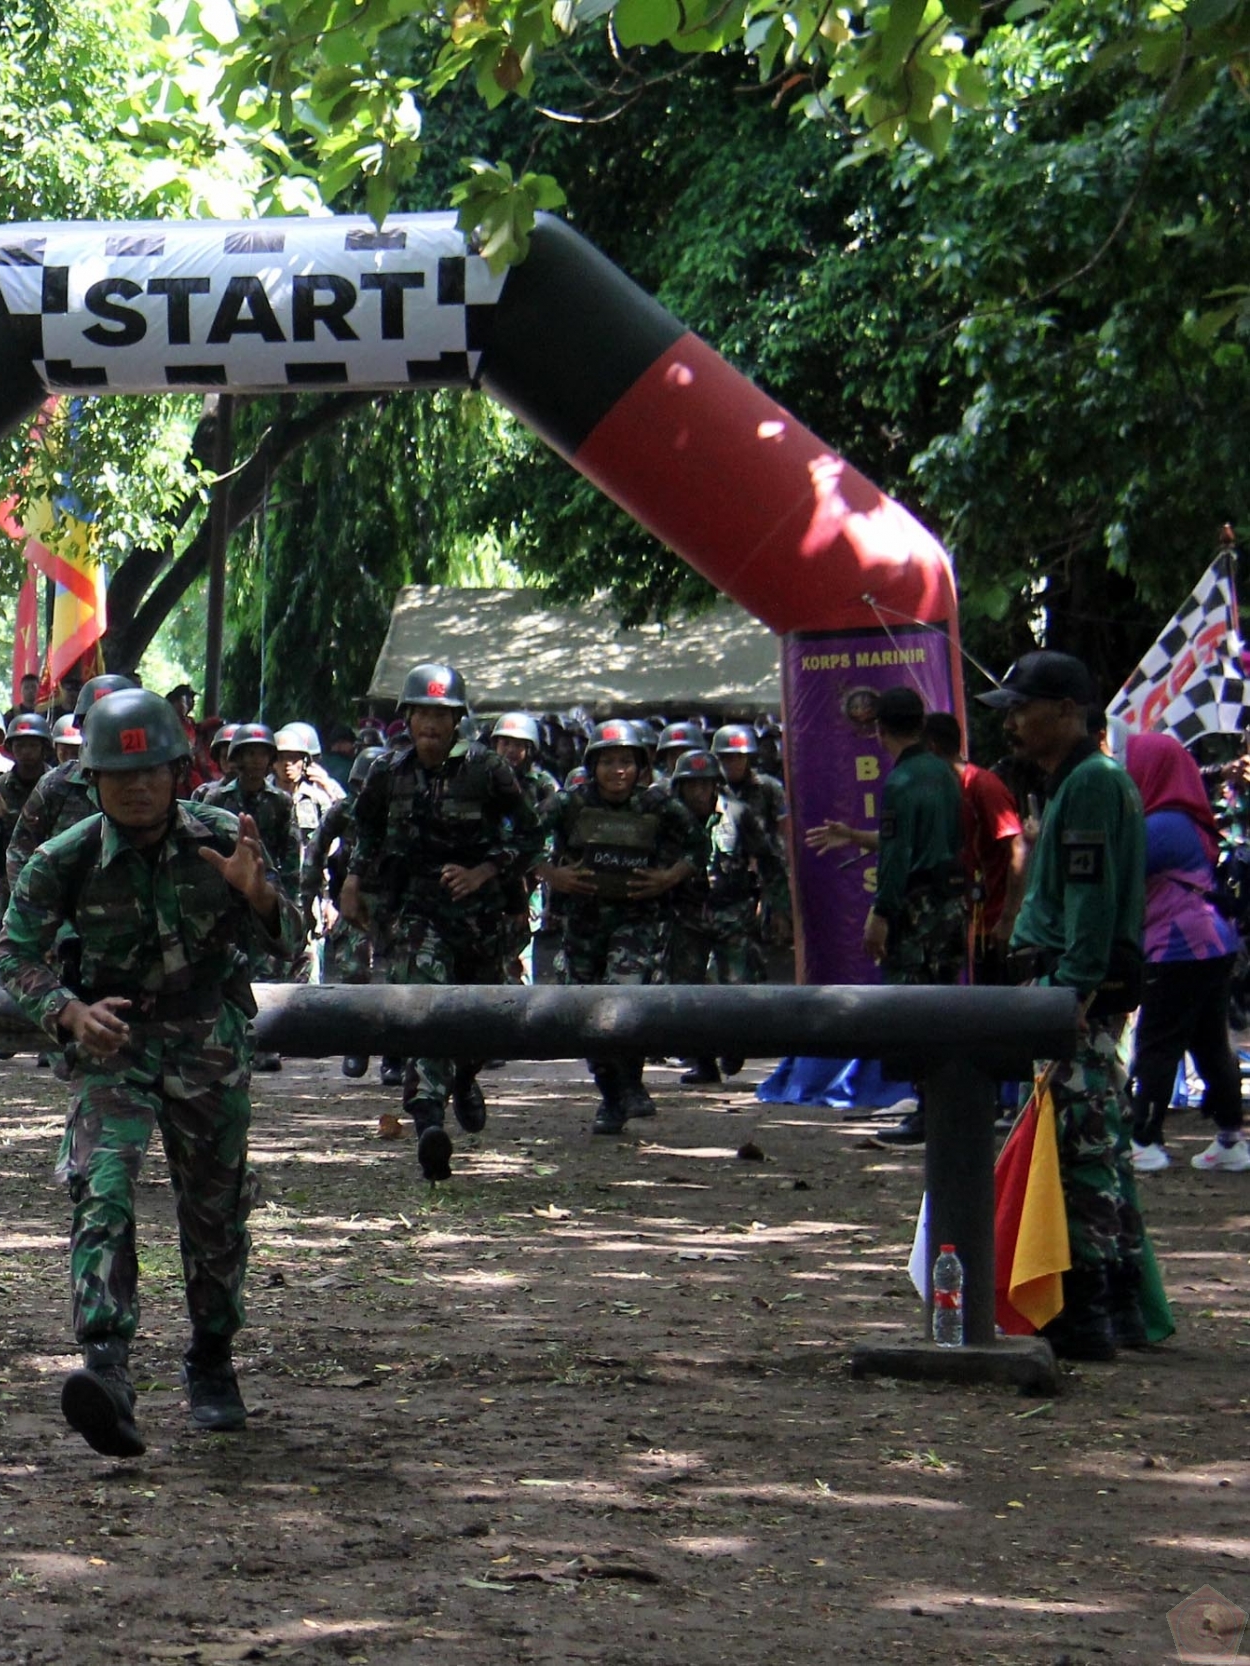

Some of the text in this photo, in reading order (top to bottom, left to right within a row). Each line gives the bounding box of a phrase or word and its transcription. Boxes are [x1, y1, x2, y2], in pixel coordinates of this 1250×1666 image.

[82, 271, 425, 347] START
[801, 648, 926, 671] KORPS MARINIR
